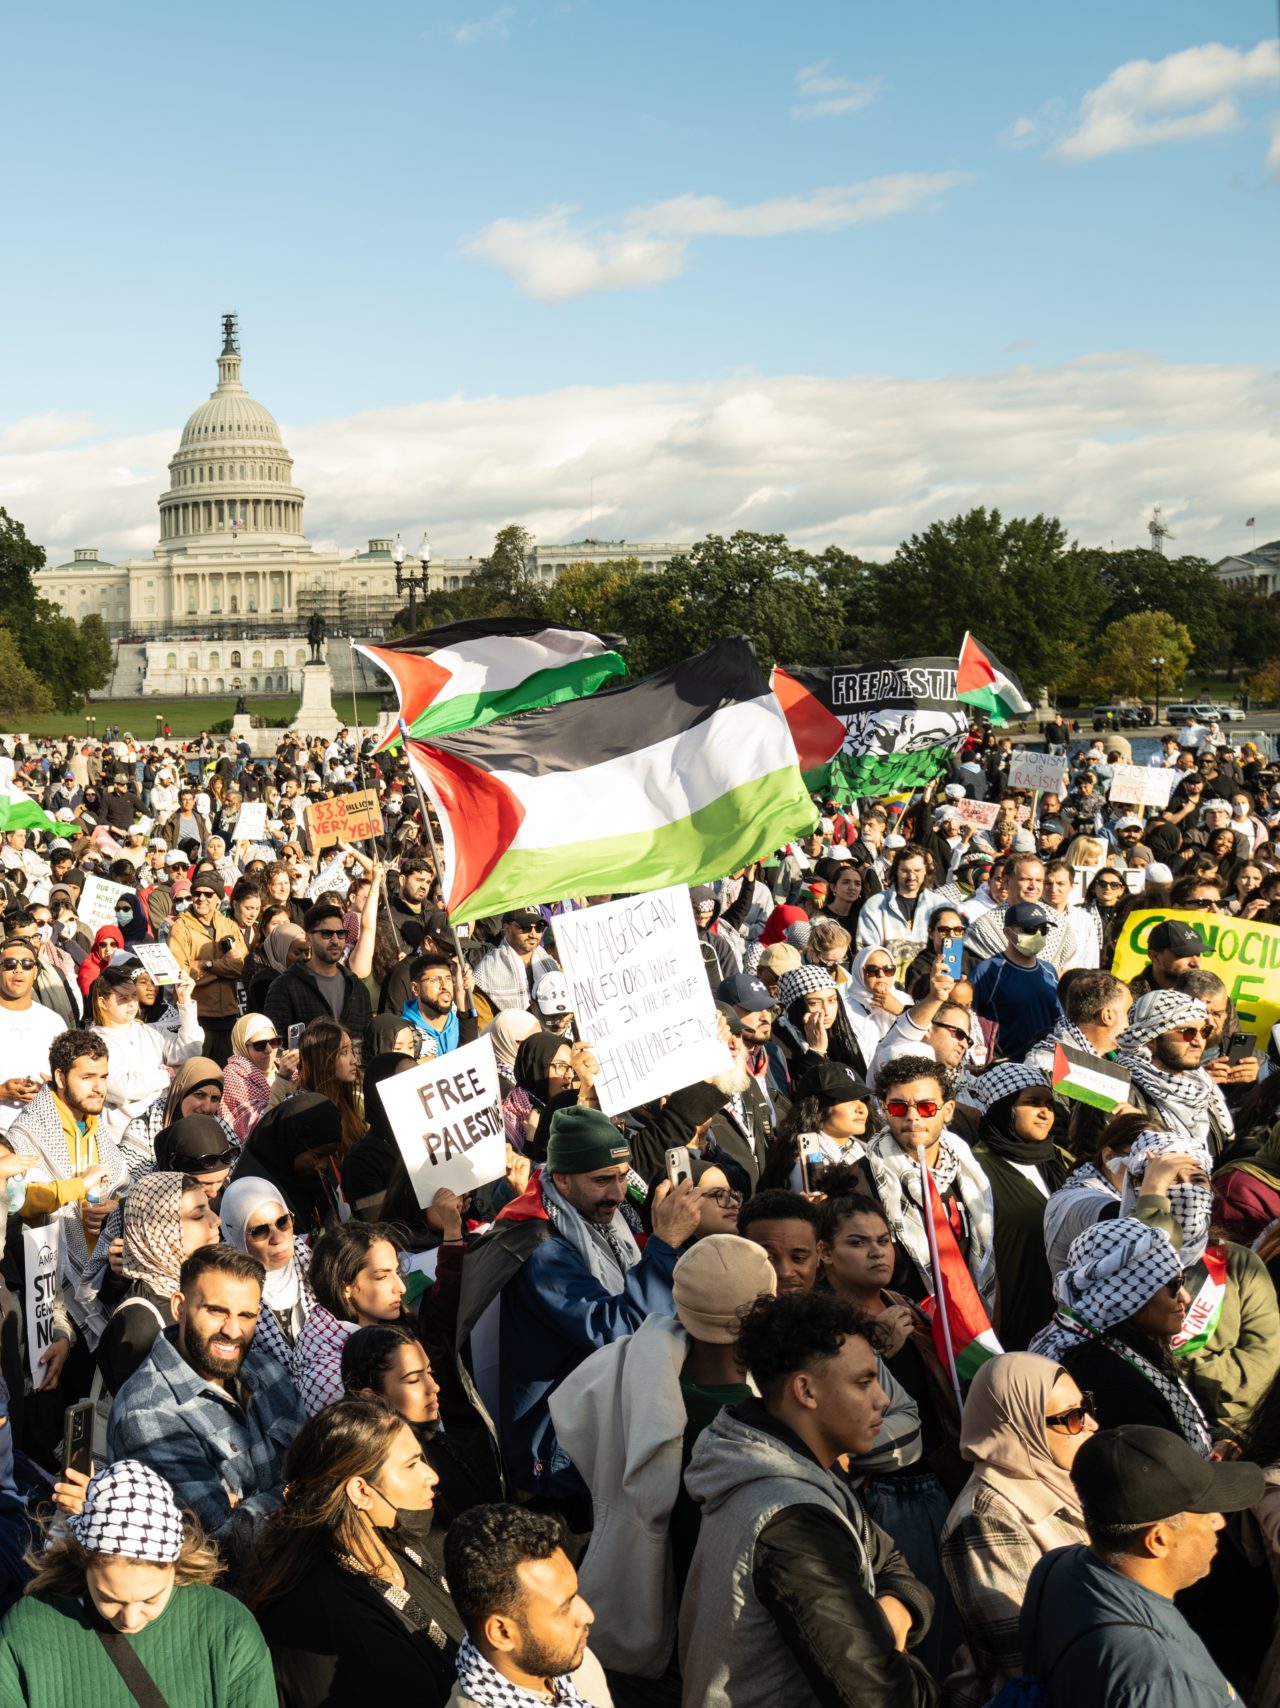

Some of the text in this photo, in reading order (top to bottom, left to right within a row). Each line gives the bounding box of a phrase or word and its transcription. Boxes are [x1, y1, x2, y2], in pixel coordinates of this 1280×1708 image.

[832, 668, 959, 705] FREE PALESTIN
[1013, 750, 1066, 767] ZIONISM
[1035, 764, 1044, 773] IS
[1014, 771, 1060, 789] RACISM
[314, 798, 374, 821] $3.8 BILLION
[348, 819, 382, 839] YEAR
[96, 883, 109, 893] OUR
[136, 944, 168, 960] FREE
[1129, 914, 1280, 970] GNOCID
[573, 964, 648, 1024] ANCESTORS
[640, 988, 671, 1014] THESE
[416, 1067, 487, 1120] FREE
[34, 1271, 57, 1302] STO
[36, 1316, 55, 1349] NO
[1170, 1297, 1214, 1349] STINE
